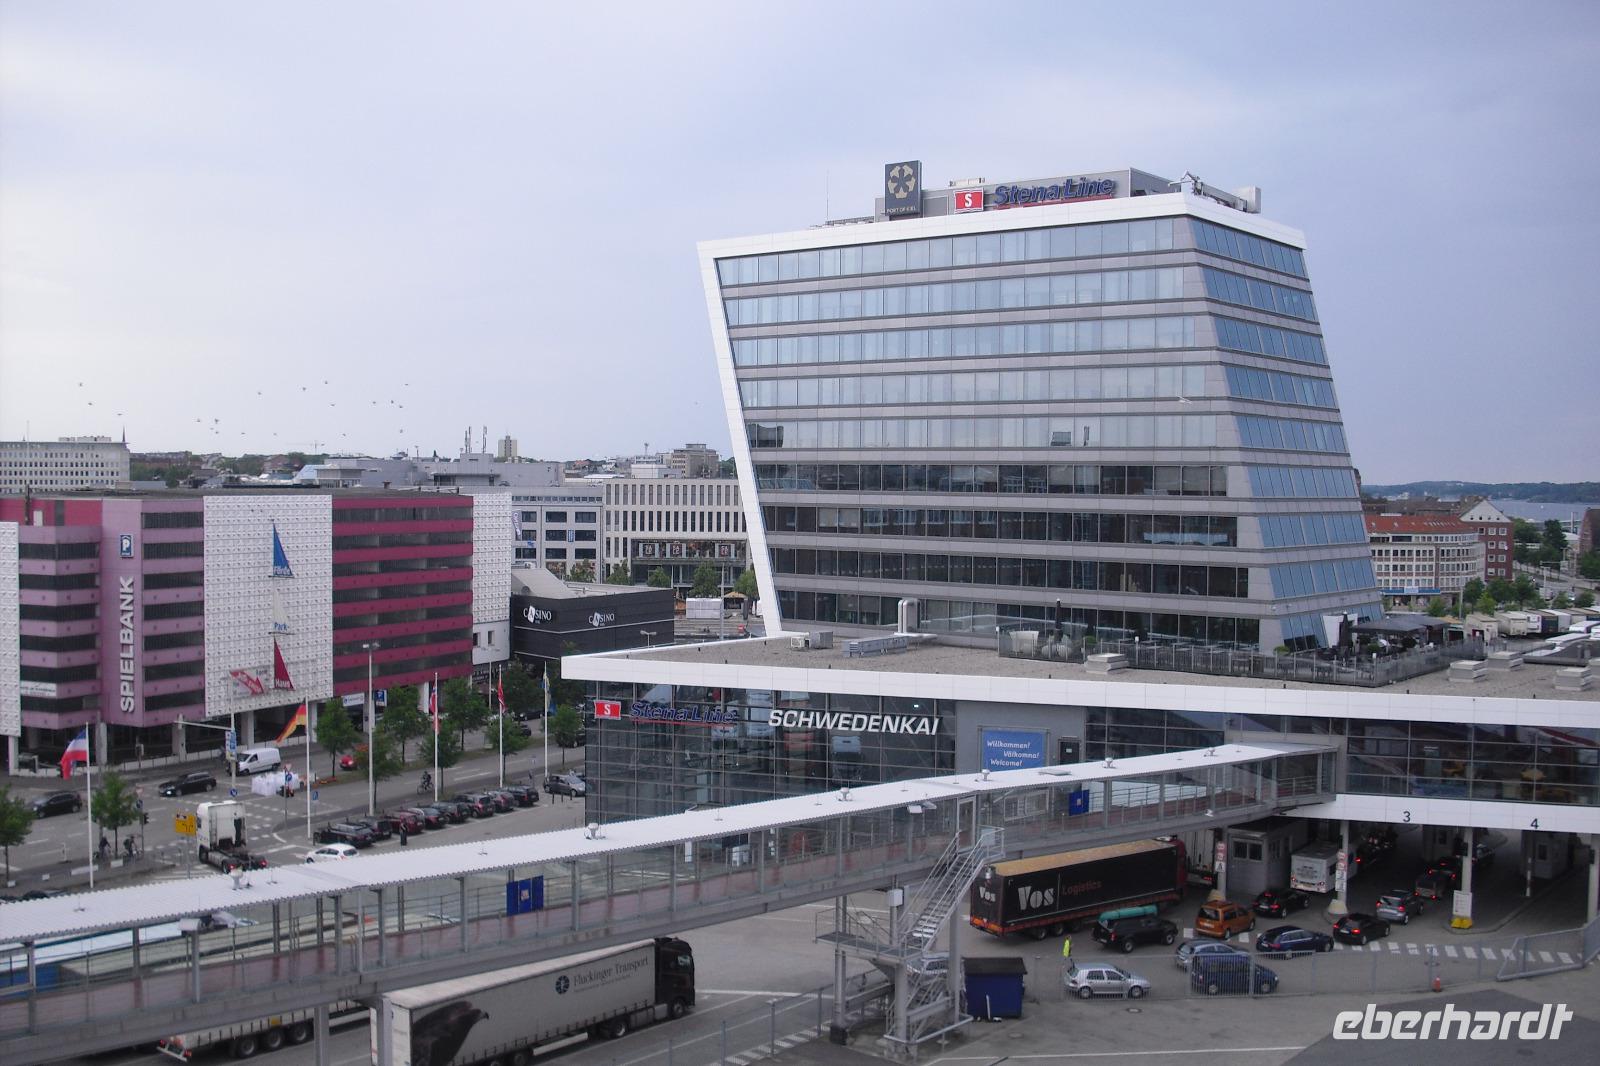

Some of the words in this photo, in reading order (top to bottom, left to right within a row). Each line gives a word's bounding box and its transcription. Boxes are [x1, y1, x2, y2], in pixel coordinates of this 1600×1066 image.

[994, 184, 1060, 204] Stena
[1063, 177, 1114, 198] Line
[523, 606, 552, 623] CASINO
[588, 612, 615, 627] CASINO
[120, 576, 134, 712] SPIELBANK
[630, 701, 688, 720] Stena
[692, 705, 737, 723] Line
[768, 709, 939, 735] SCHWEDENKAI
[987, 740, 1031, 749] Willkommen!
[990, 759, 1022, 767] Welcome!
[1403, 811, 1411, 822] 3
[1530, 818, 1539, 829] 4
[979, 886, 996, 902] Vos
[1018, 886, 1055, 911] Vos
[615, 956, 648, 975] Transport
